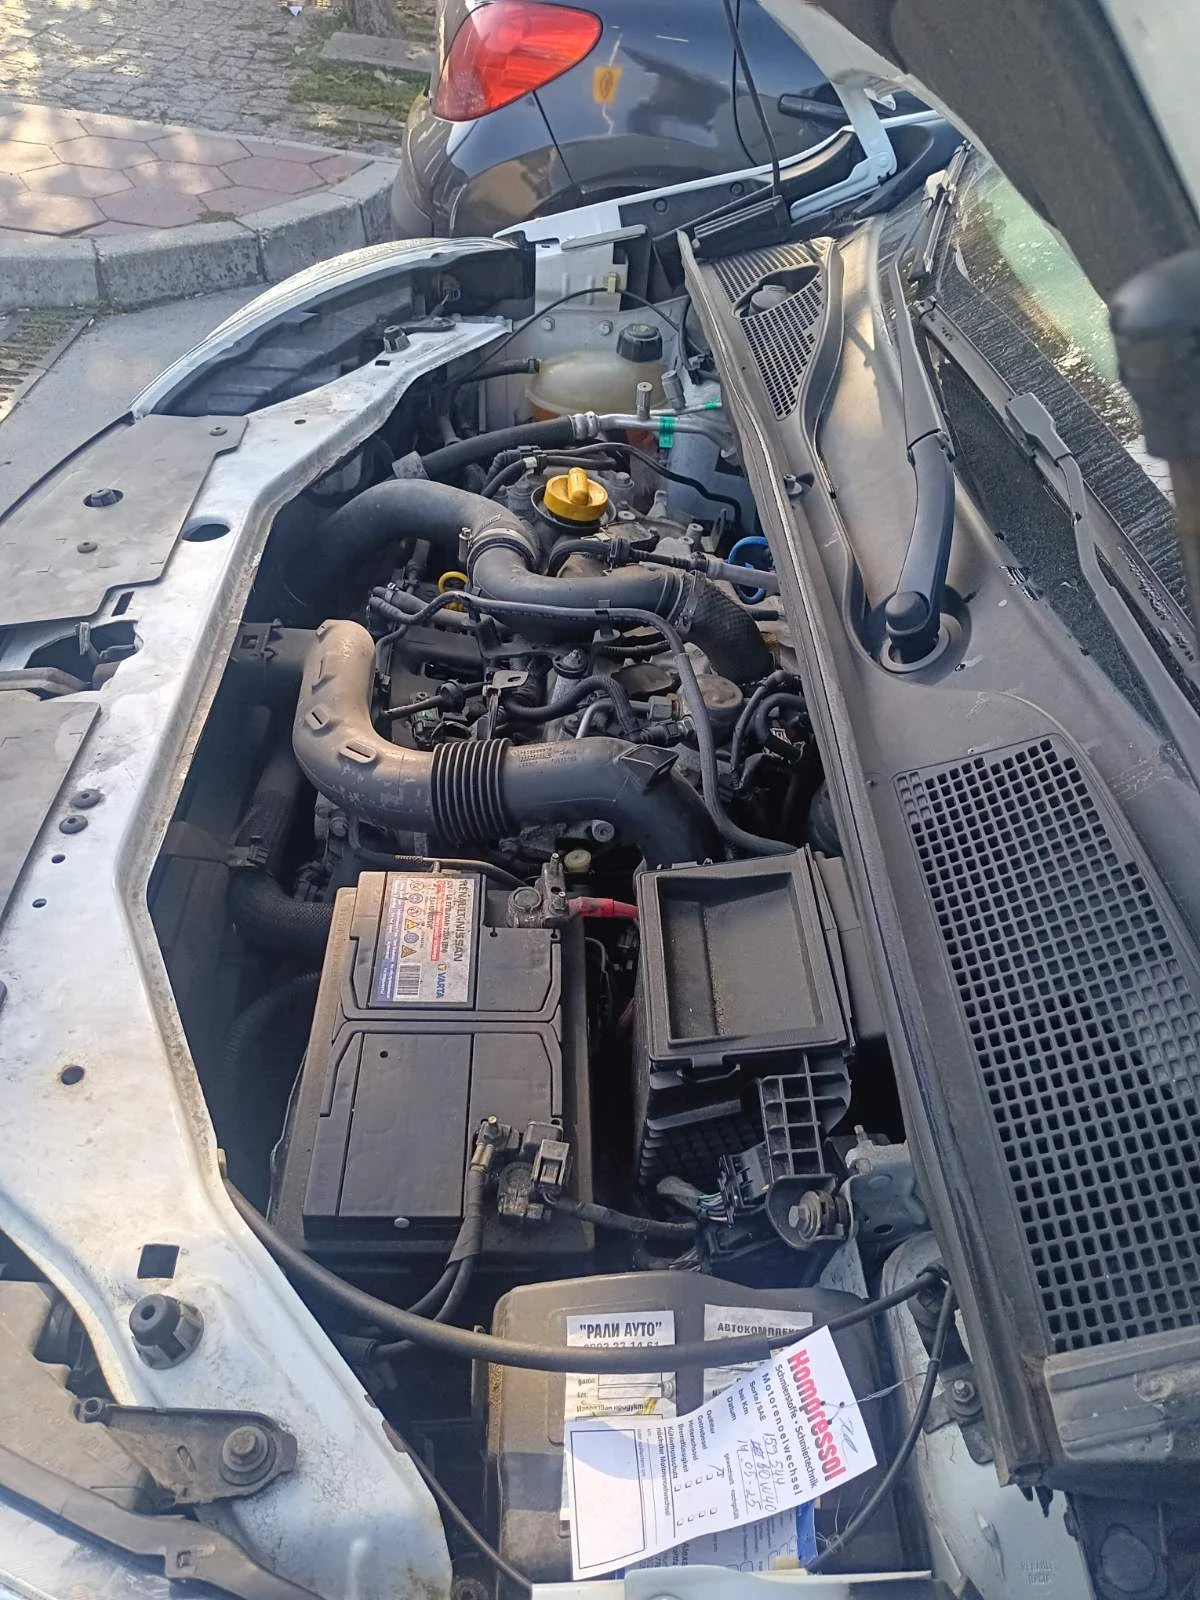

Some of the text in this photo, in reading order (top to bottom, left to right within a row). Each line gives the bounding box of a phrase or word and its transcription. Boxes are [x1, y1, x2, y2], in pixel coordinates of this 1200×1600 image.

[436, 972, 446, 998] VARTA
[580, 1322, 620, 1339] "РАЛИ
[717, 1322, 800, 1337] АВТОКОМПЛЕК
[727, 1395, 737, 1421] Datum
[787, 1349, 847, 1482] Kompressol
[762, 1373, 803, 1496] Motorenoelwechsel
[775, 1364, 818, 1489] Schmierstoffe Schmiertechnik
